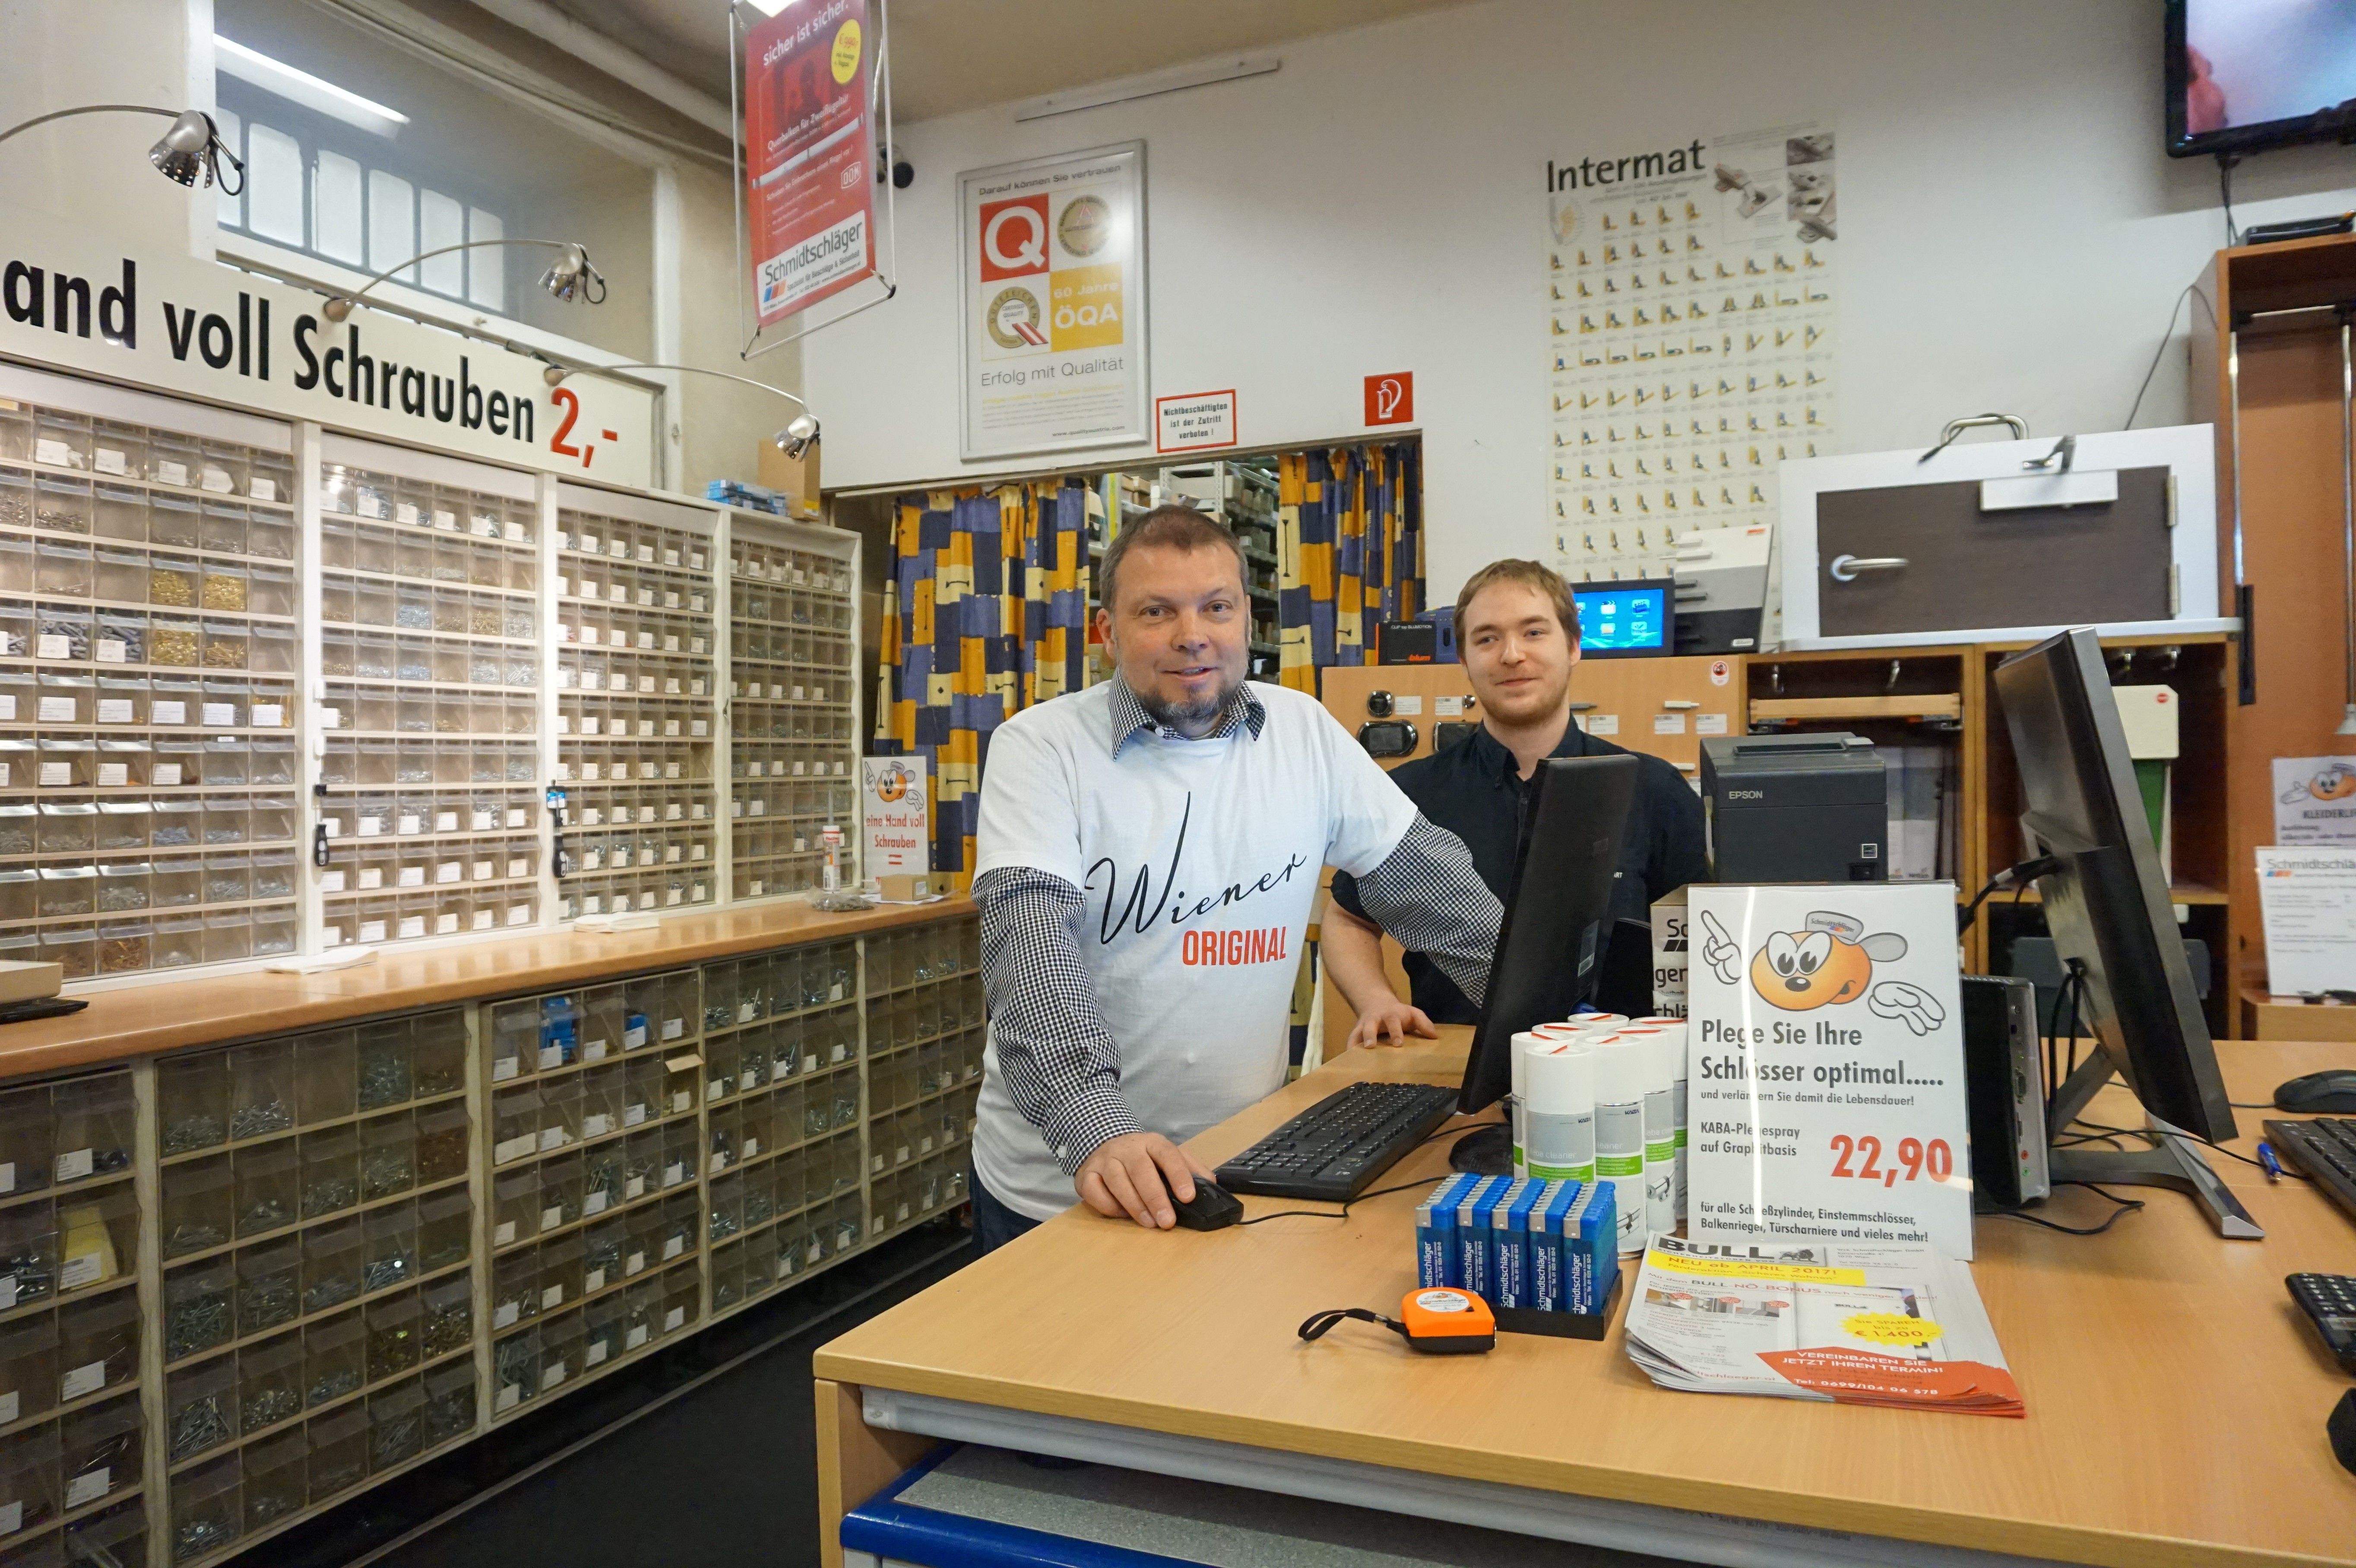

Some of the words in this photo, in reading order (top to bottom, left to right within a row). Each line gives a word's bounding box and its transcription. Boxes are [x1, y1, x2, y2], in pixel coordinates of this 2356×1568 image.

[763, 35, 794, 66] sicher
[797, 22, 811, 42] ist
[843, 165, 860, 185] DOM
[1548, 138, 1706, 193] Intermat
[979, 183, 1011, 196] Darauf
[1014, 177, 1050, 190] können
[1053, 174, 1068, 182] Sie
[1072, 165, 1121, 179] vertrauen
[985, 205, 1046, 268] Q
[765, 222, 862, 286] Schmidtschläger
[1054, 287, 1073, 300] 60
[1077, 282, 1118, 296] Jahre
[1054, 303, 1118, 329] ÖQA
[162, 292, 270, 381] voll
[294, 314, 535, 443] Schrauben
[550, 386, 618, 468] 2,-
[982, 370, 1025, 386] Erfolg
[1032, 365, 1055, 380] mit
[1061, 357, 1124, 376] Qualität
[1163, 403, 1228, 416] Nichtbeschäftigten
[1170, 419, 1180, 428] ist
[1183, 418, 1194, 427] der
[1197, 414, 1222, 425] Zutritt
[1178, 429, 1209, 439] verboten
[1729, 790, 1763, 799] EPSON
[866, 816, 883, 827] eine
[885, 814, 907, 827] Hand
[909, 813, 925, 828] voll
[874, 834, 916, 849] Schrauben
[1084, 791, 1307, 945] Wiener
[1182, 926, 1287, 967] ORIGINAL
[1773, 1021, 1807, 1044] Sie
[1816, 1021, 1862, 1046] Ihre
[1701, 1089, 1718, 1099] und
[1722, 1089, 1773, 1101] verlänern
[1777, 1091, 1792, 1101] Sie
[1795, 1091, 1823, 1103] damit
[1827, 1092, 1843, 1103] die
[1846, 1093, 1915, 1106] Lebensdauer!
[1700, 1122, 1800, 1140] KABA-Pleespray
[1545, 1151, 1577, 1159] cleaner
[1700, 1140, 1720, 1153] auf
[1830, 1135, 1954, 1189] 22,90
[1700, 1201, 1714, 1213] für
[1717, 1202, 1736, 1214] alle
[1739, 1204, 1815, 1220] Scheßzylinder,
[1818, 1208, 1916, 1226] Einstemmschlösser,
[1769, 1222, 1838, 1236] Türscharniere
[1841, 1227, 1860, 1238] und
[1864, 1228, 1894, 1240] vieles
[1898, 1230, 1929, 1242] mehr!
[1658, 1237, 1775, 1260] BULL
[1668, 1257, 1701, 1266] NEU
[1737, 1264, 1784, 1272] APRIL
[1792, 1267, 1837, 1275] 2017!
[1783, 1358, 1826, 1366] JETZT
[1831, 1360, 1875, 1370] IHREN
[1879, 1365, 1944, 1373] TERMIN!
[1796, 1351, 1899, 1365] VEREINBAREN
[1821, 1380, 1884, 1391] 0699/104
